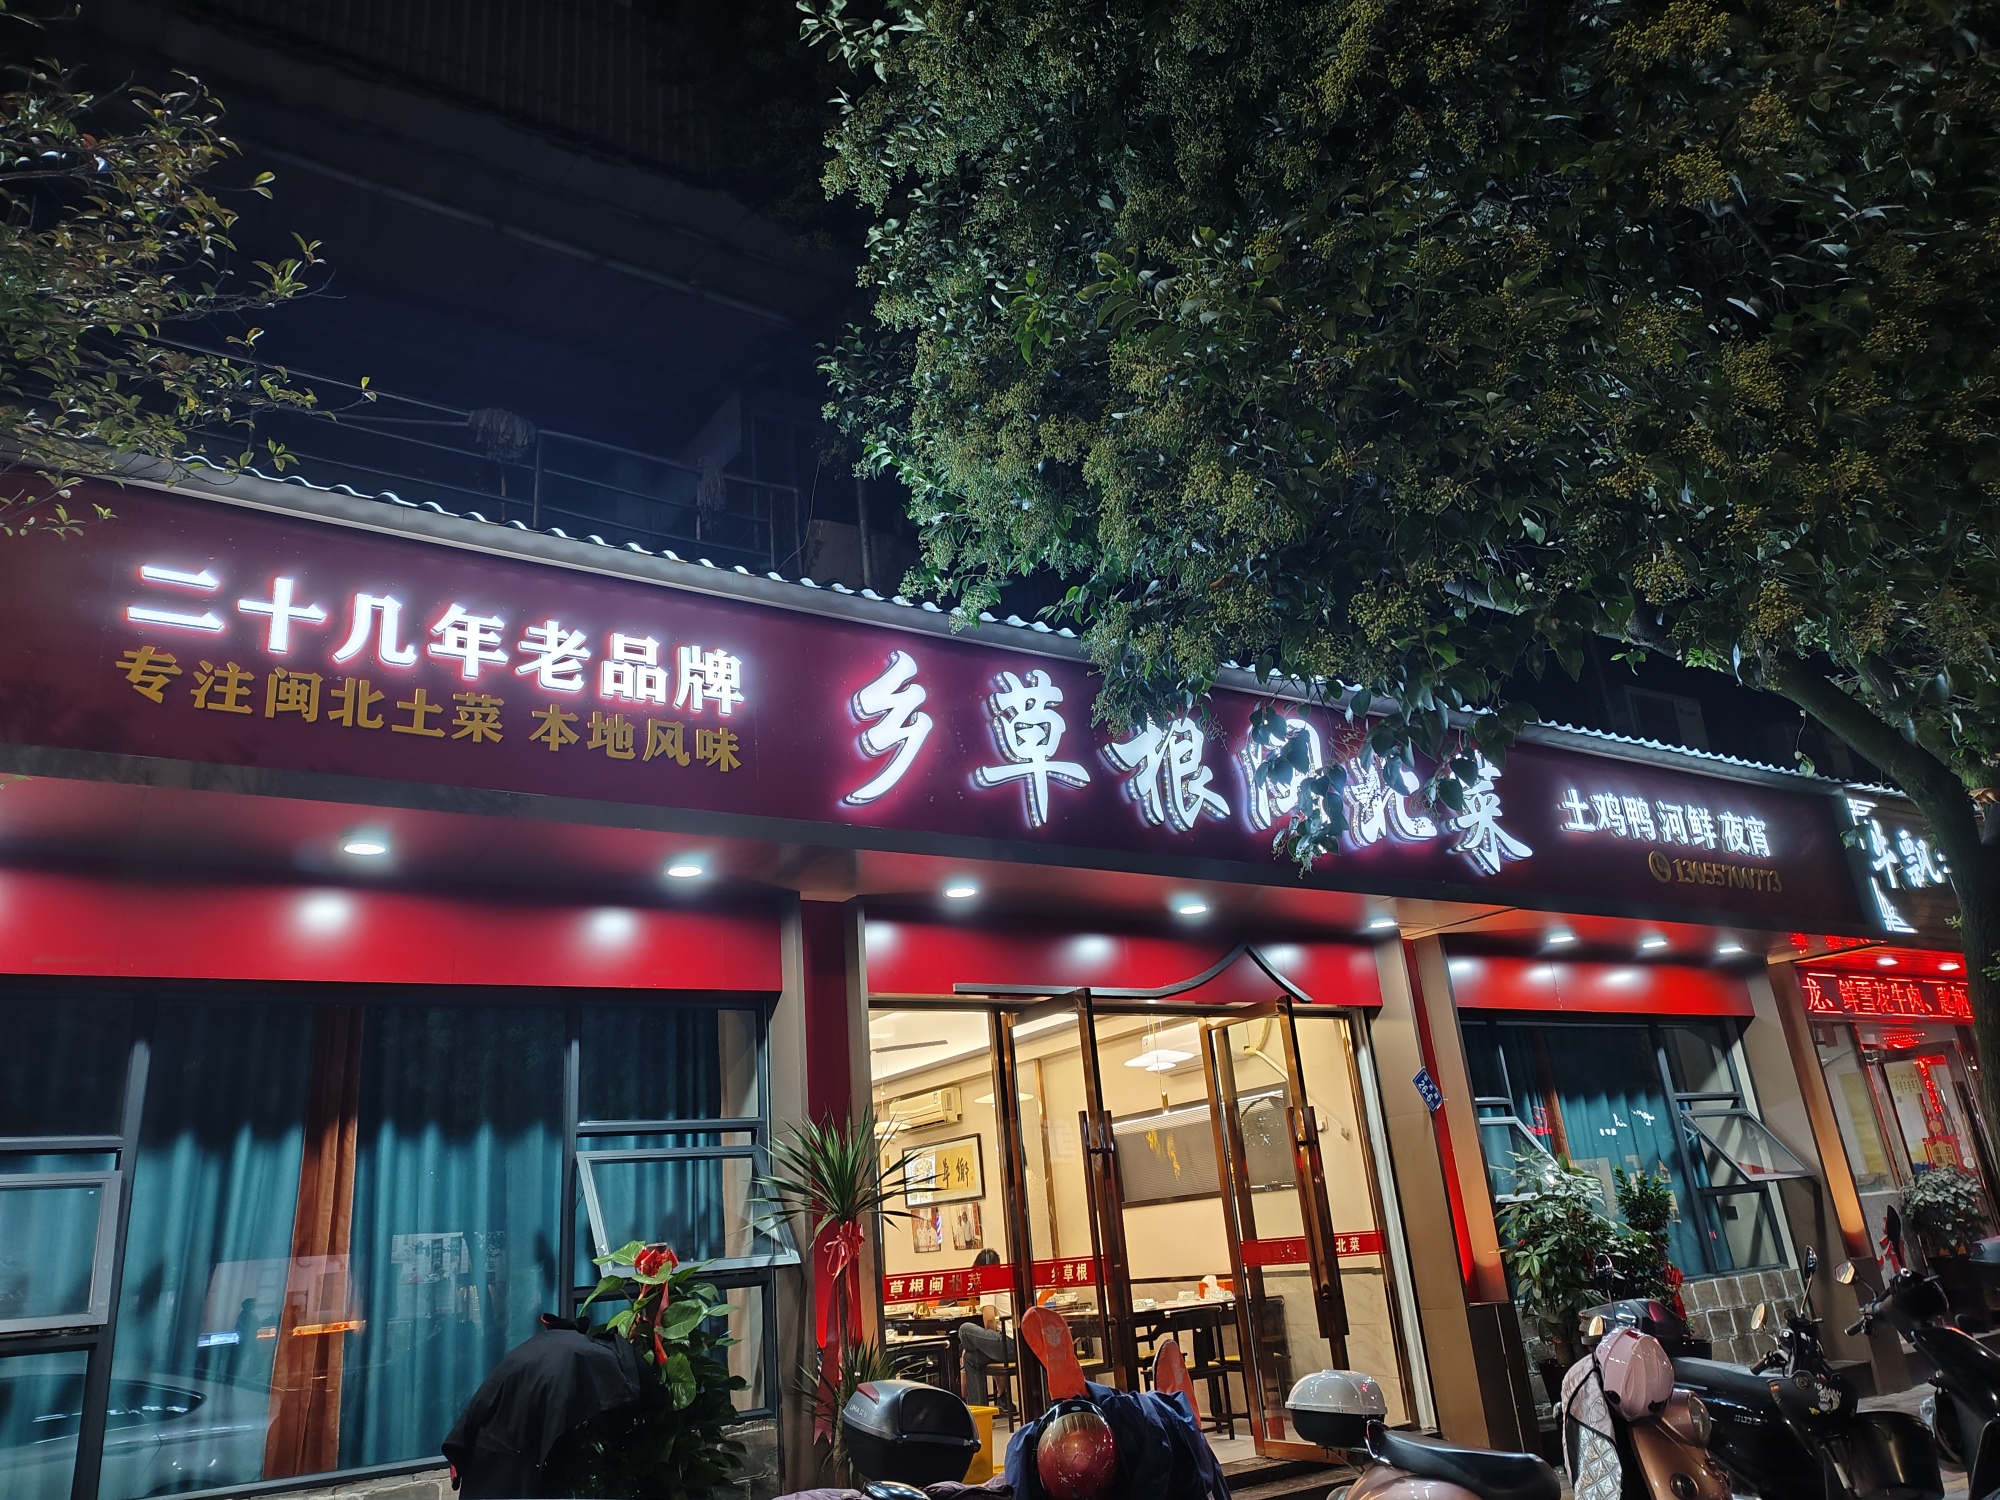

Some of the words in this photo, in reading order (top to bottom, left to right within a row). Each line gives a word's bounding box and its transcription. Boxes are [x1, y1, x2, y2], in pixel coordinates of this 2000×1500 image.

[125, 563, 746, 717] 二十几年老品牌
[115, 645, 505, 744] 专注闽北土菜
[529, 703, 742, 773] 本地风味
[1560, 788, 1656, 842] 土鸡鸭
[1655, 800, 1717, 850] 河鲜
[1718, 811, 1771, 858] 夜宵
